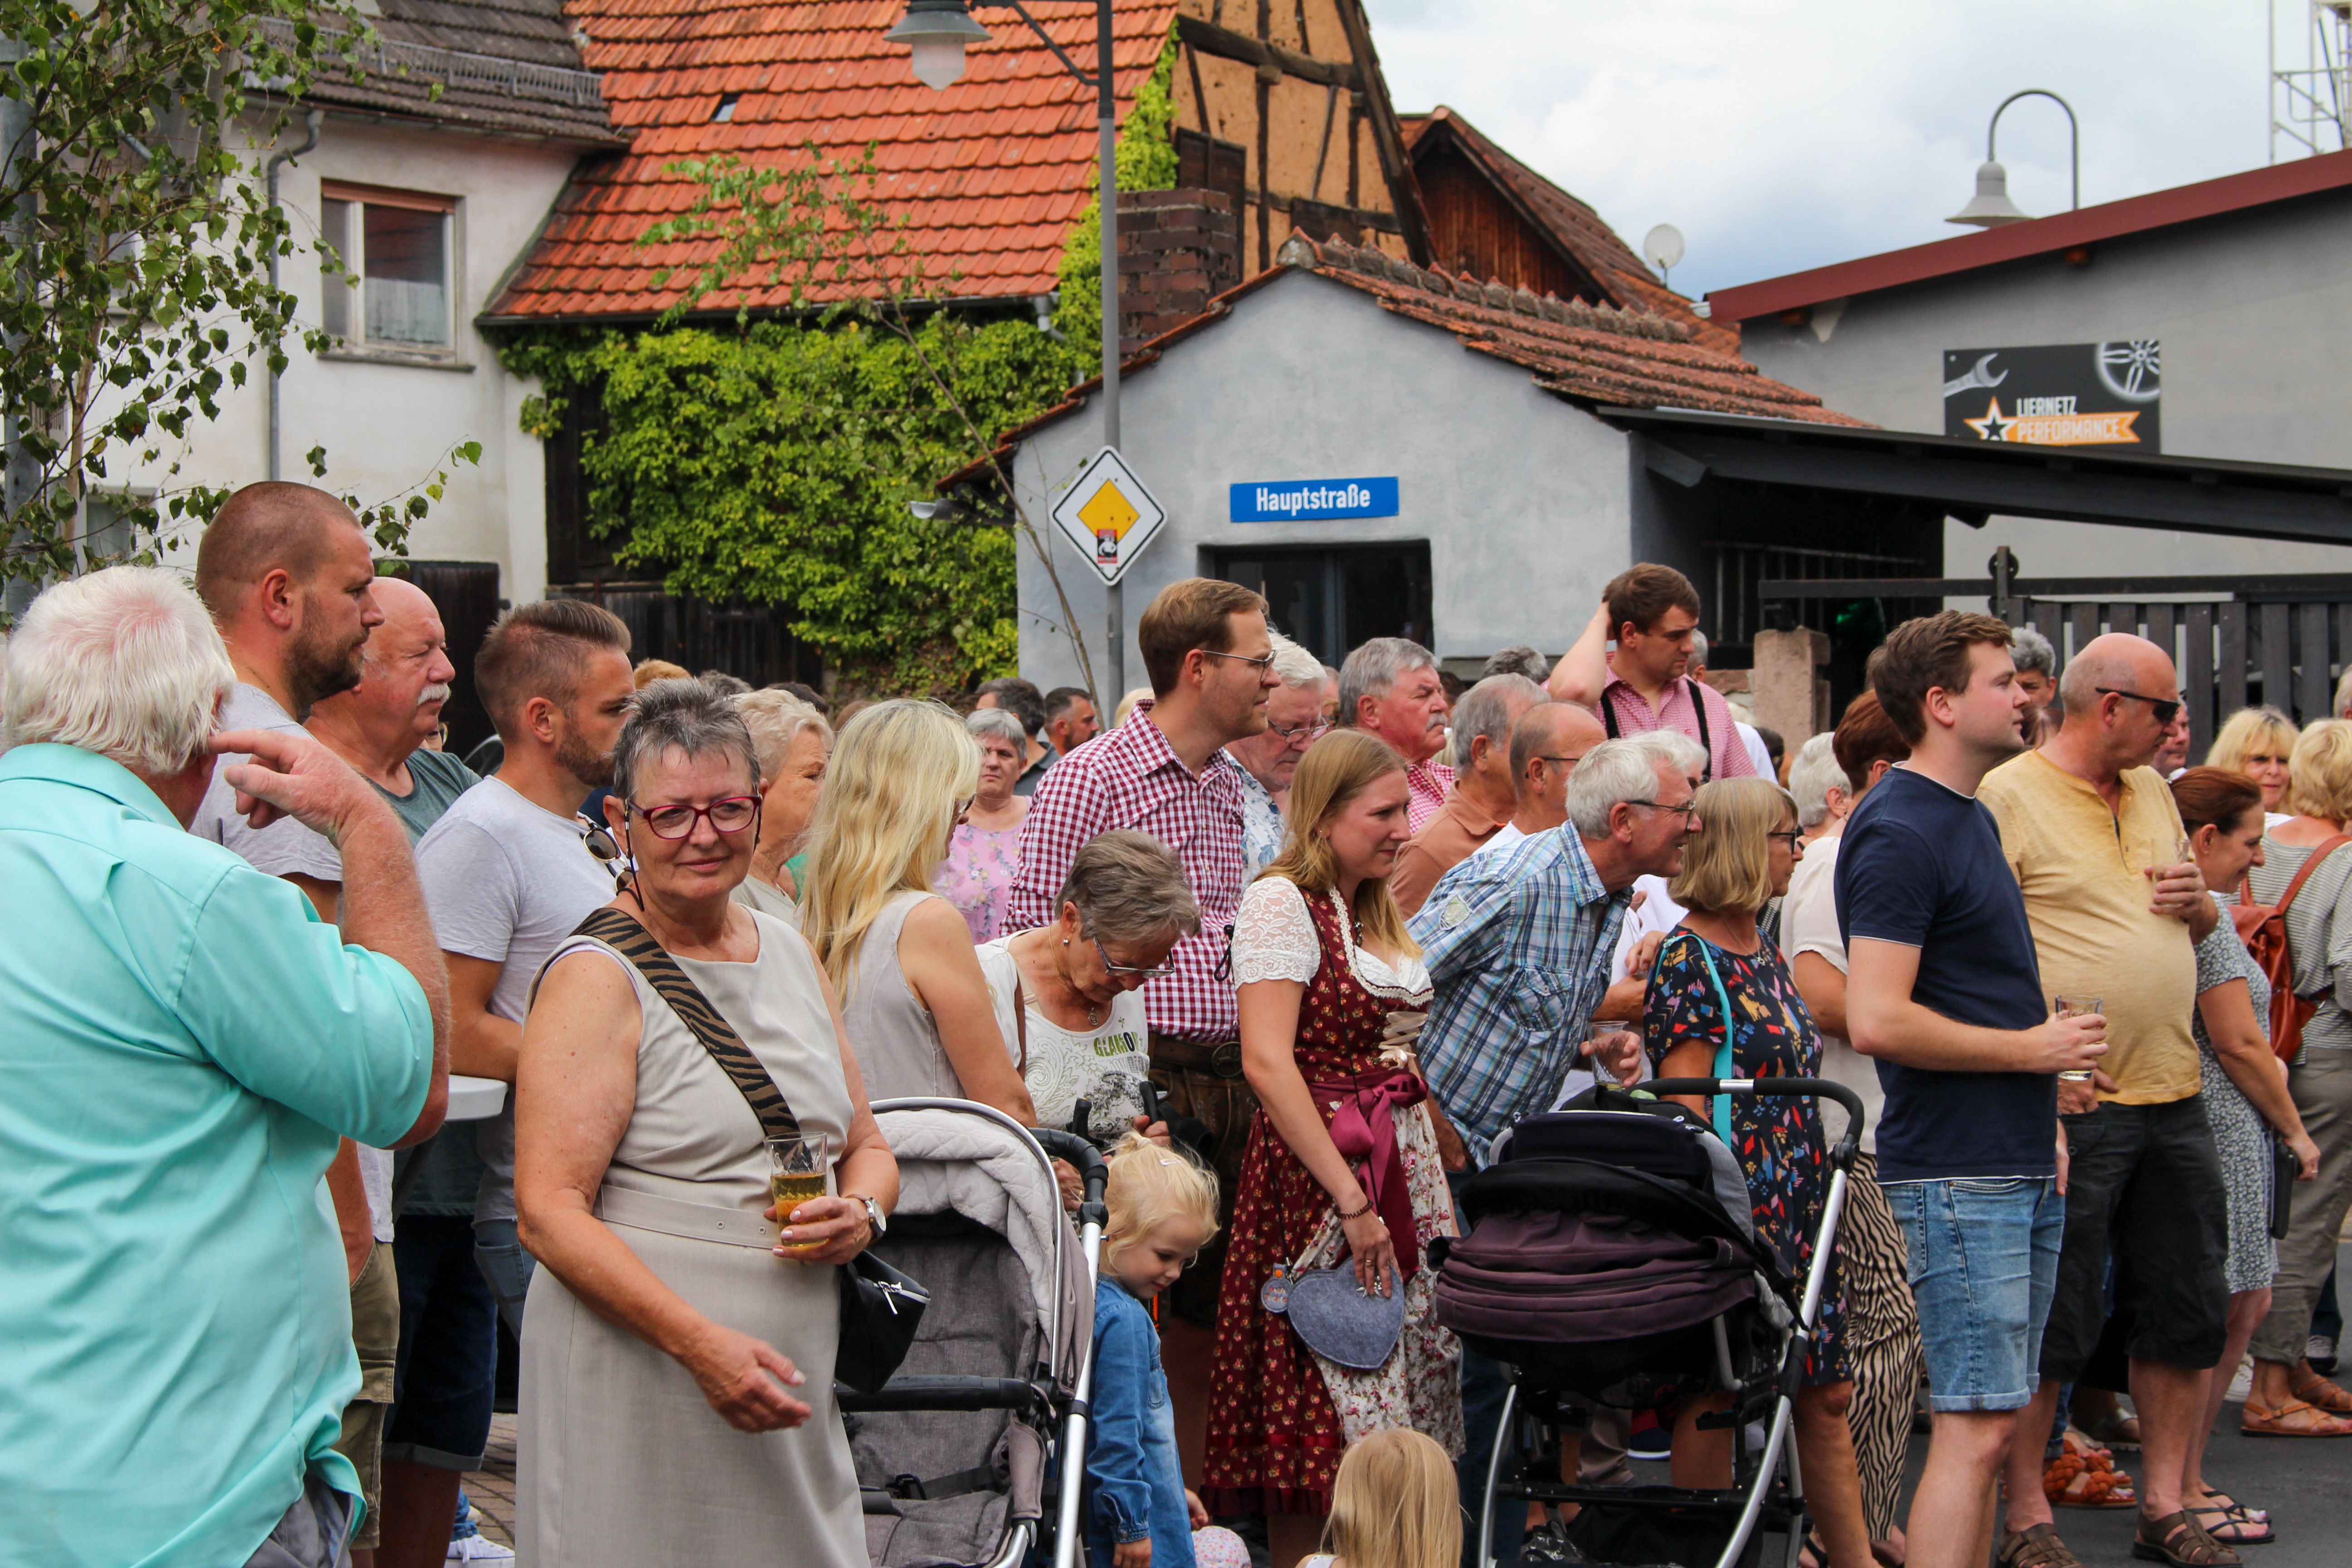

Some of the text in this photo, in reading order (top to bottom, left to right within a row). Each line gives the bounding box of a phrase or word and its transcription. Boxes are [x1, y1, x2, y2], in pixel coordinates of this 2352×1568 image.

[2017, 396, 2078, 416] LIERNETZ
[2018, 418, 2121, 441] PERFORMANCE
[1256, 483, 1371, 516] Hauptstraße
